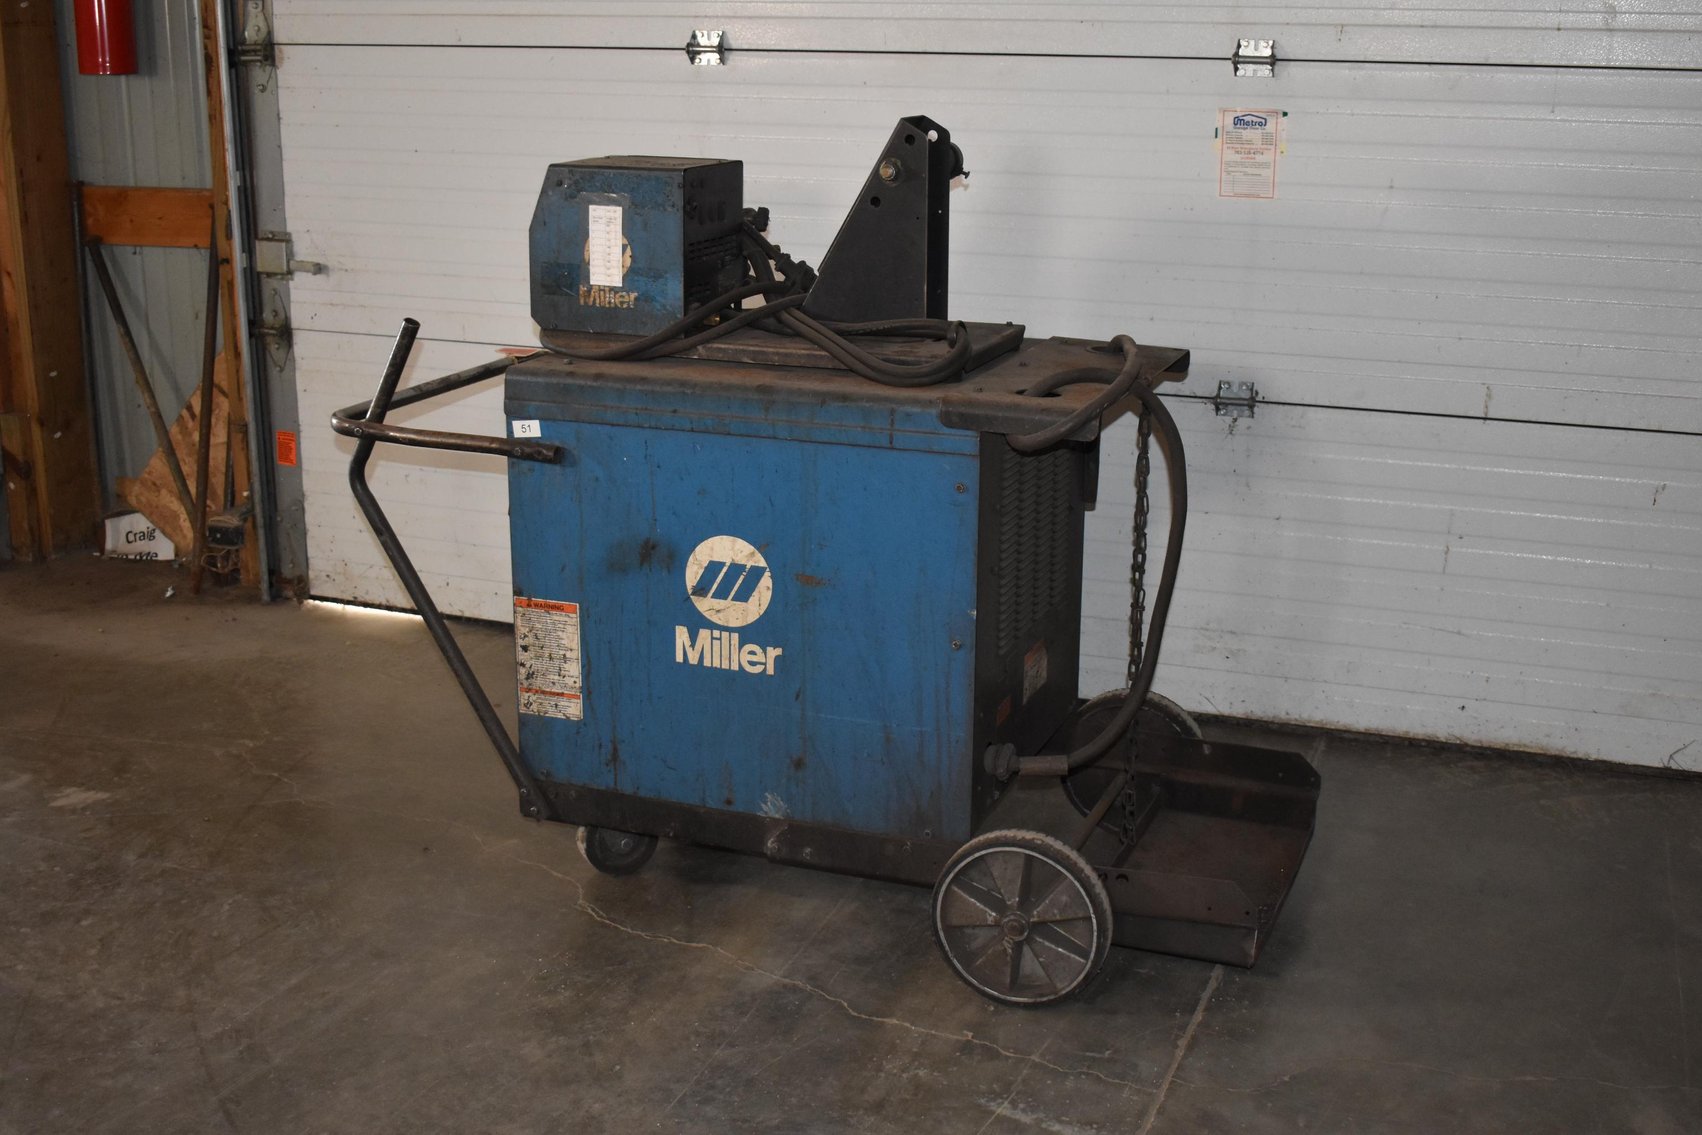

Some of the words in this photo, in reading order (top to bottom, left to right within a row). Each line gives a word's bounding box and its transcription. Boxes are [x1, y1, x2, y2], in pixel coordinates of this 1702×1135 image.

[1233, 117, 1265, 127] Metro
[579, 285, 638, 308] Miller
[521, 424, 532, 433] 51
[125, 526, 156, 544] Craig
[533, 602, 564, 611] WARNING
[675, 625, 783, 675] Miller
